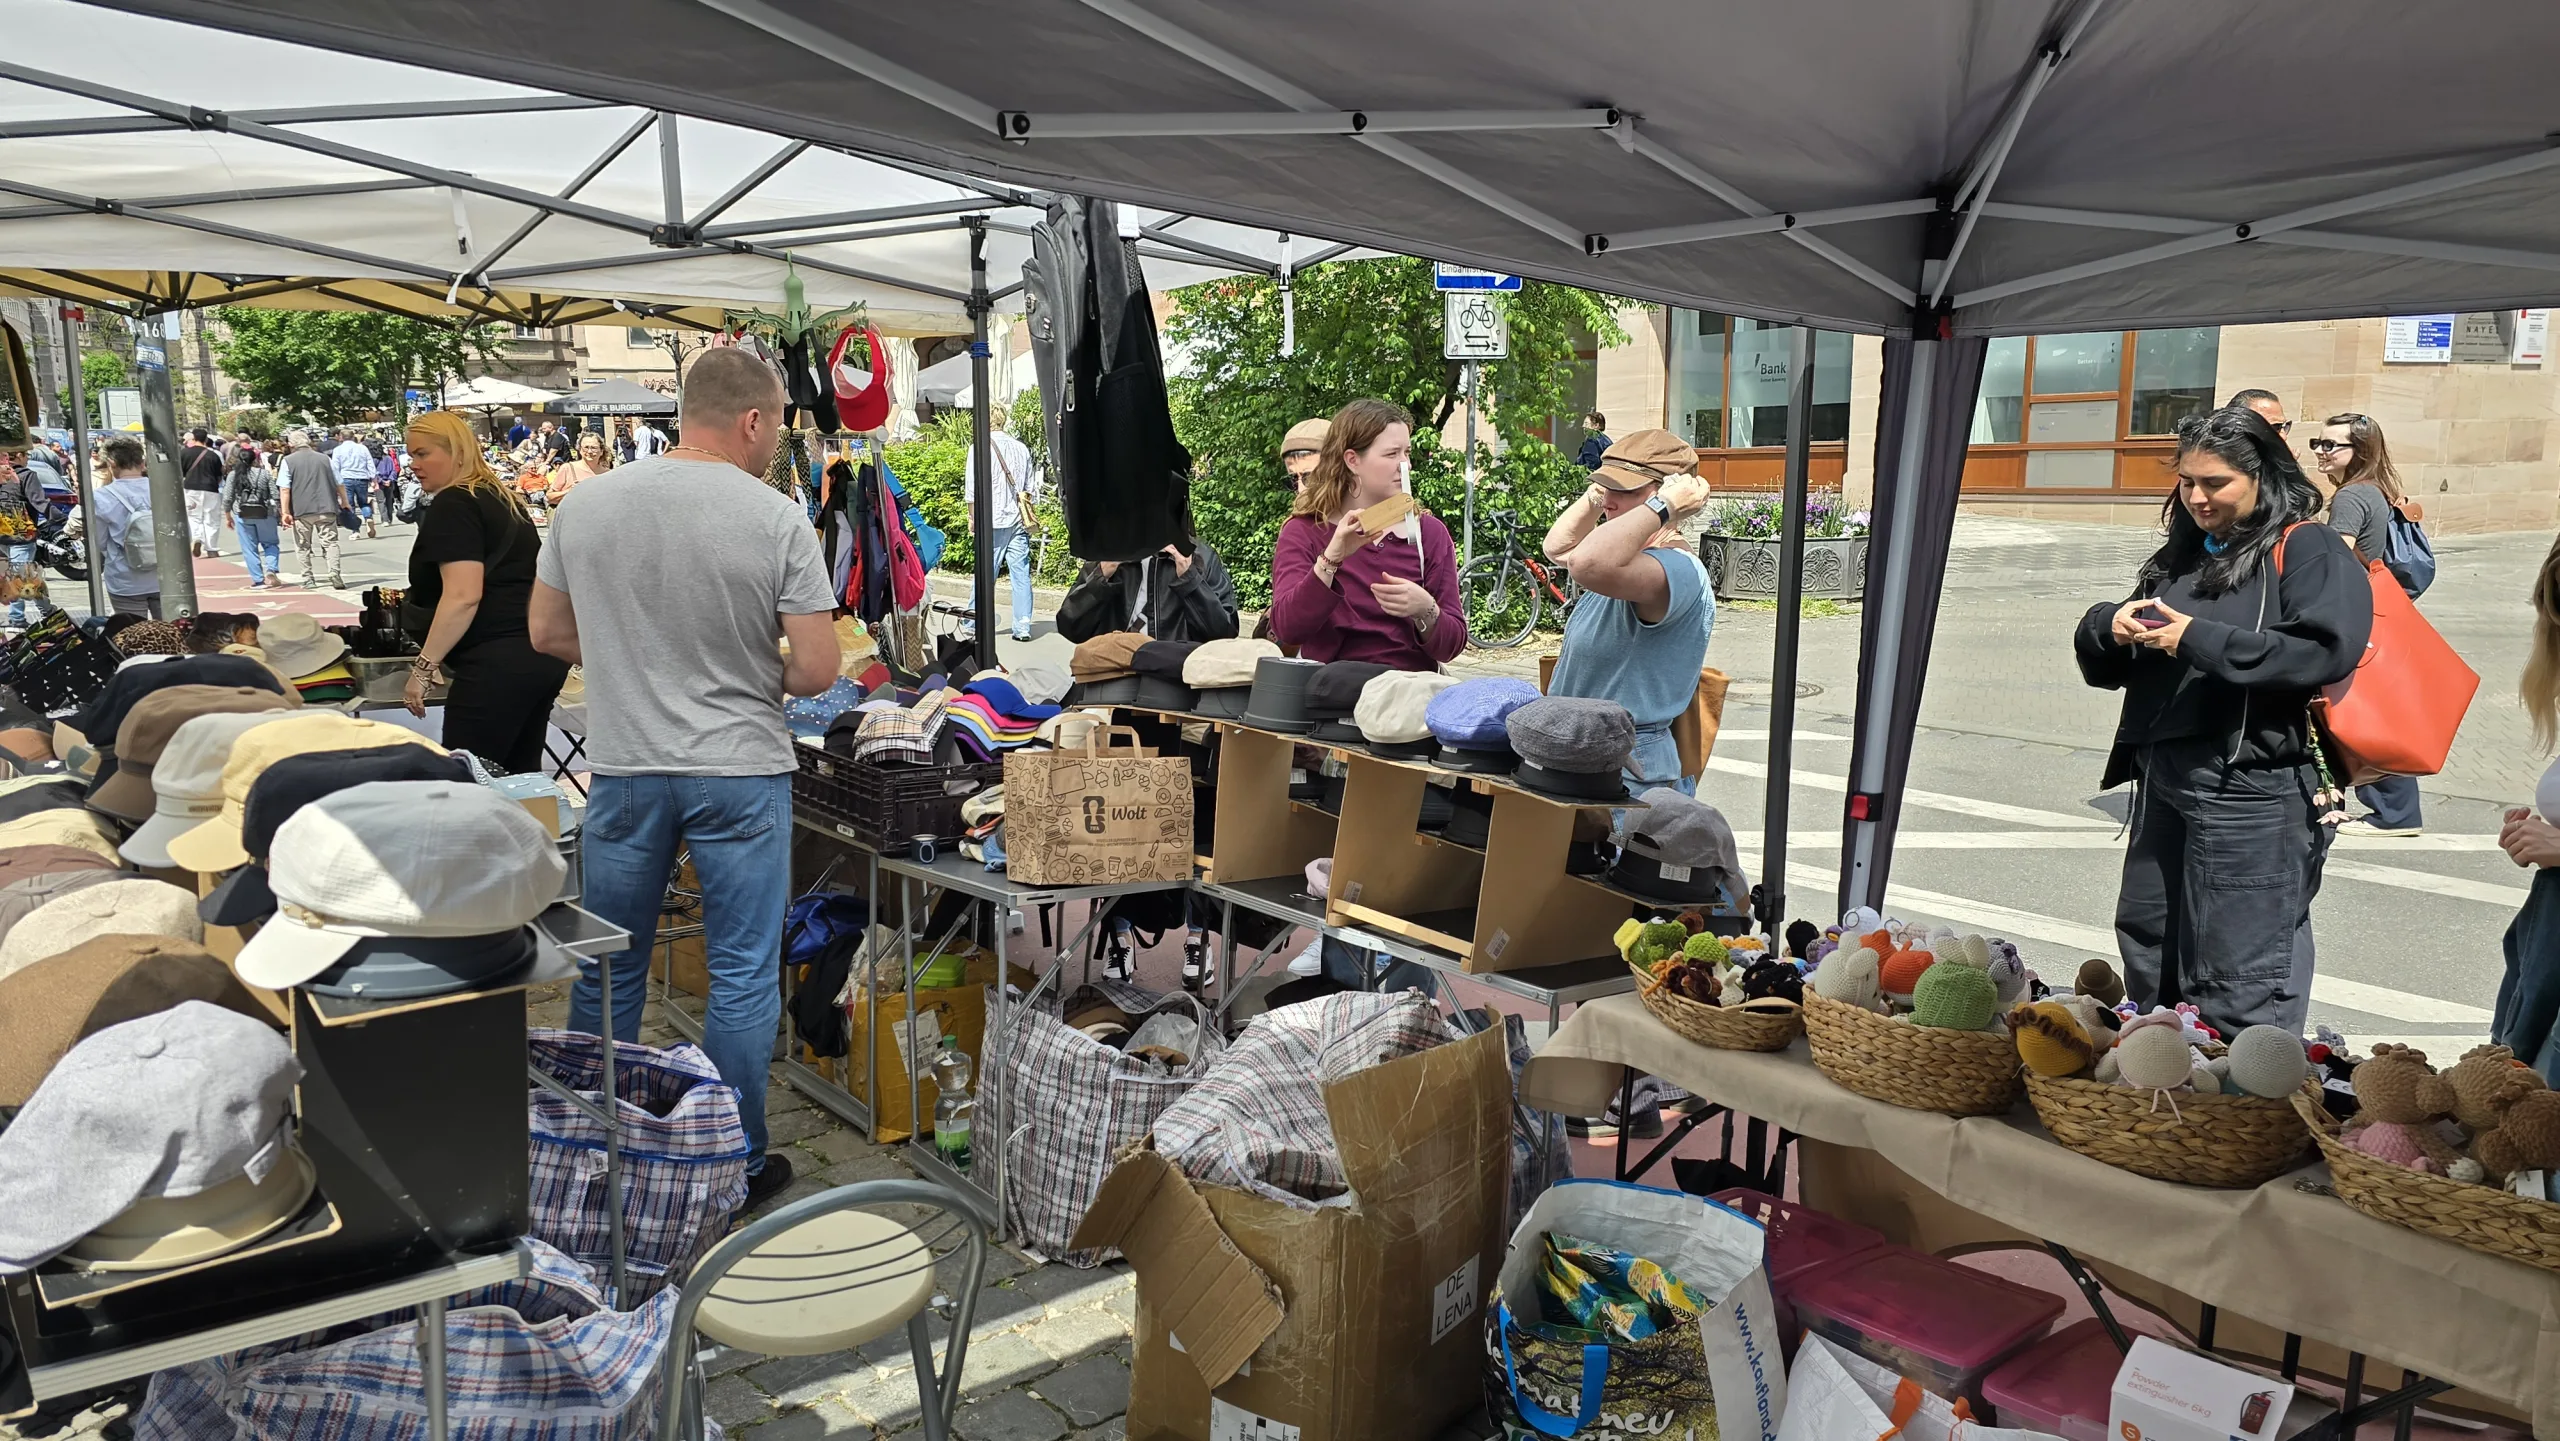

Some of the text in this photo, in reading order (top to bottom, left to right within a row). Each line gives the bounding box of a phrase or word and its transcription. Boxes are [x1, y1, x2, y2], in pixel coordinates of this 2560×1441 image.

[1760, 361, 1787, 375] Bank
[609, 403, 643, 411] BURGER
[1112, 805, 1148, 821] Wolt
[1446, 1266, 1466, 1299] DE
[1436, 1291, 1473, 1336] LENA
[2131, 1371, 2171, 1391] Powder
[2127, 1380, 2212, 1419] extinguisher 6kg
